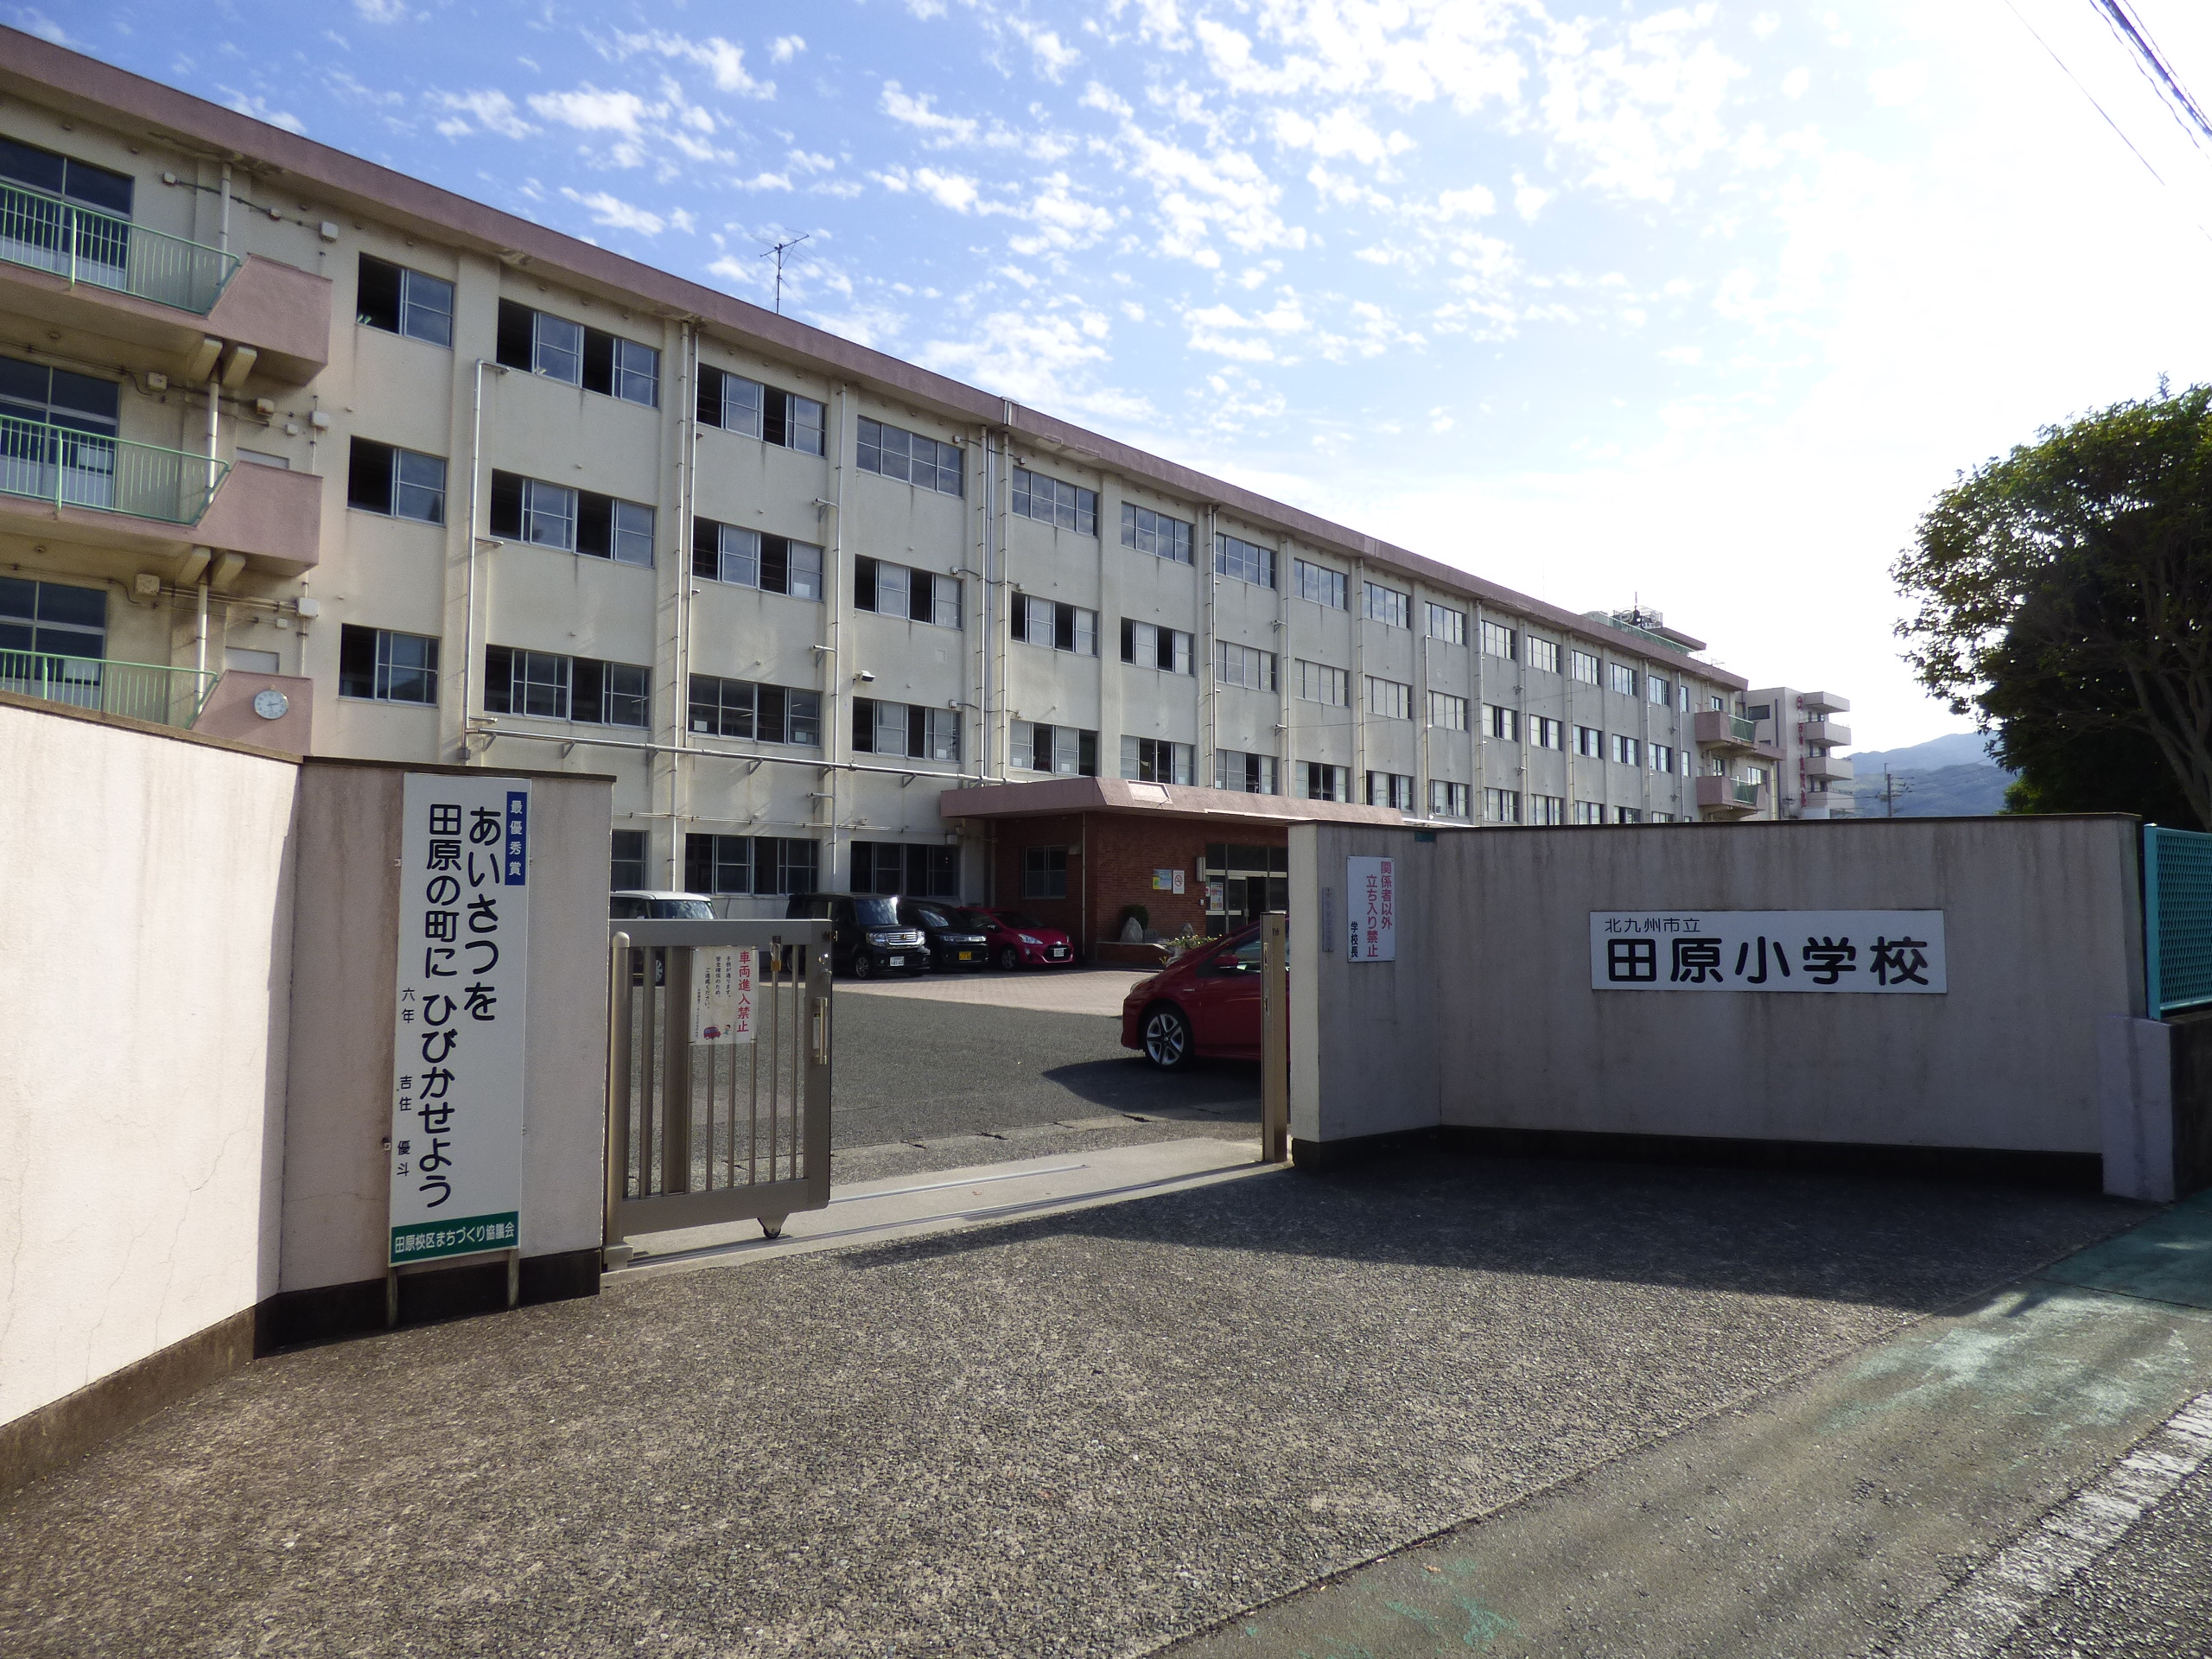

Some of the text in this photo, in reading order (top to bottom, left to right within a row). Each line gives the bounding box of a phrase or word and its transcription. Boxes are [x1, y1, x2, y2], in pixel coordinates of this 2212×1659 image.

[510, 800, 523, 876] 最優秀賞
[463, 806, 501, 1021] あいさつを
[1366, 874, 1379, 957] 立ち入り禁止
[1381, 861, 1393, 930] 関係者以外
[1605, 918, 1701, 933] 北九州市立
[737, 951, 752, 1033] 車両進入禁止
[1607, 936, 1929, 986] 田原小学校
[418, 804, 462, 1208] 田原の町にひびかせよう
[397, 988, 416, 1177] 六年 吉住 優斗
[395, 1221, 515, 1254] 田原校区まちづくり協議会
